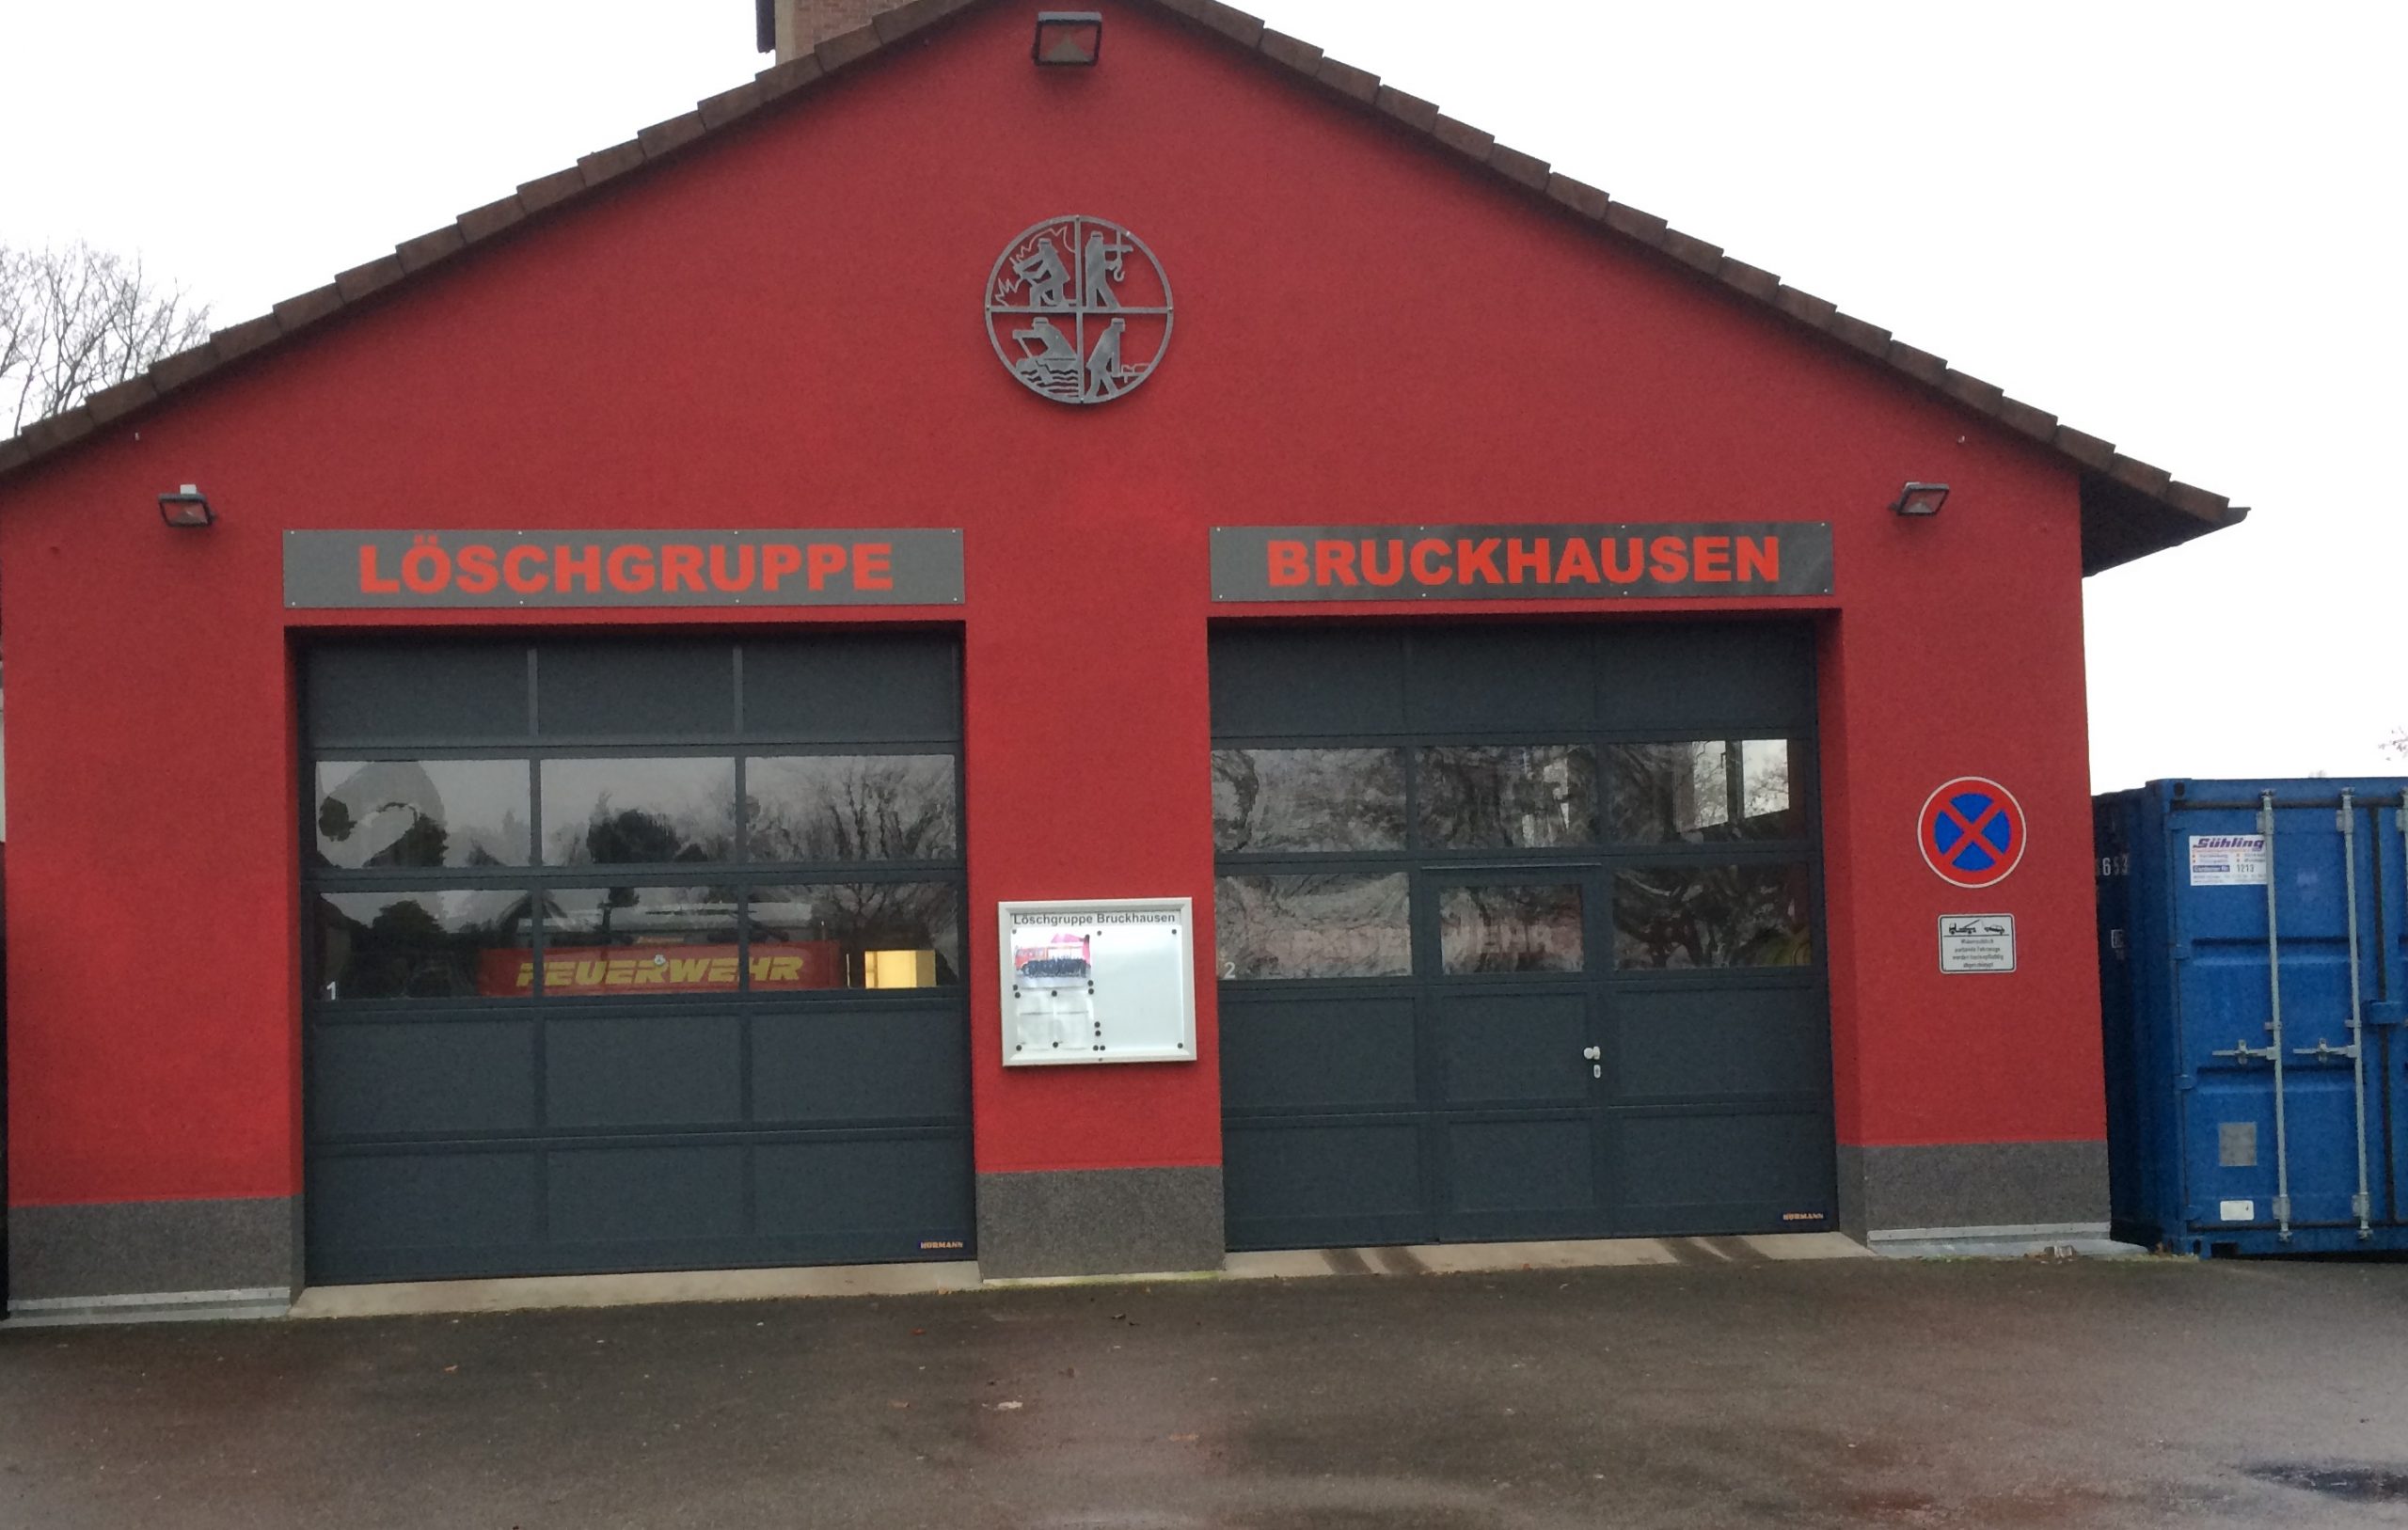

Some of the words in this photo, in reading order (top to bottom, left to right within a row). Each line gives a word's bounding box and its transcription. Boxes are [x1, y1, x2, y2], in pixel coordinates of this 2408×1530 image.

[357, 534, 895, 596] LÖSCHGRUPPE
[1267, 536, 1781, 587] BRUCKHAUSEN
[2193, 837, 2265, 852] Sühling
[1013, 913, 1093, 926] Löschgruppe
[1097, 912, 1176, 924] Bruckhausen
[516, 955, 803, 986] FEUERWEHR
[1224, 961, 1236, 979] 2
[326, 981, 336, 1001] 1
